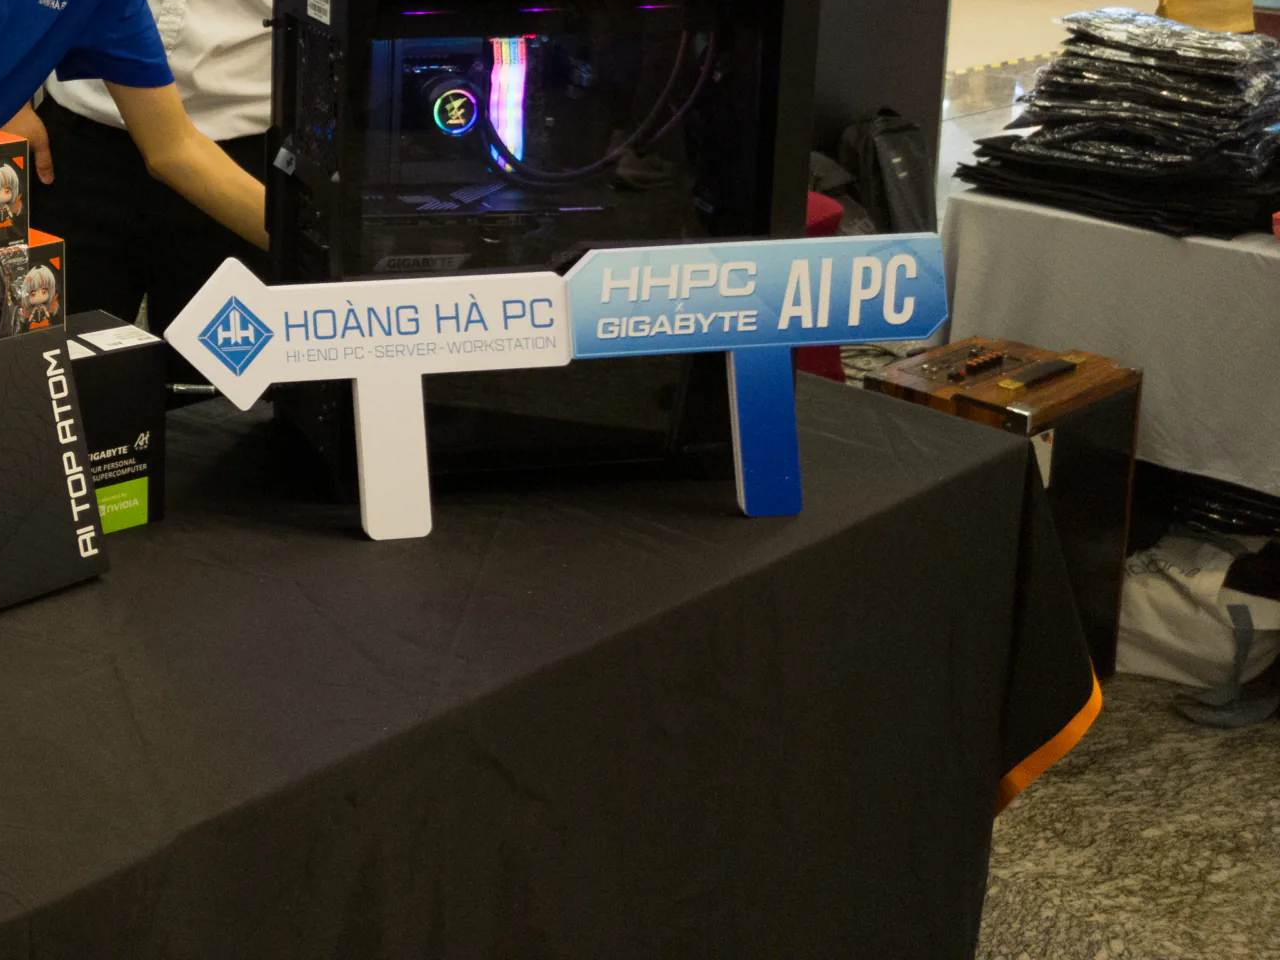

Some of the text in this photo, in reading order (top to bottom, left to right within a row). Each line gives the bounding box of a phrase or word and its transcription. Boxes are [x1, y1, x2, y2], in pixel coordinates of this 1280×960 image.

[601, 260, 757, 303] HHPC
[777, 254, 917, 330] AI PC
[283, 293, 555, 342] HOÀNG HÀ PC
[597, 310, 758, 339] GIGABYTE
[447, 335, 557, 355] WORKSTATION
[42, 348, 99, 558] AI TOP ATOM
[88, 445, 128, 461] IGABYTE
[103, 457, 136, 471] PERSONAL
[92, 463, 147, 482] SUPERCOMPUTER
